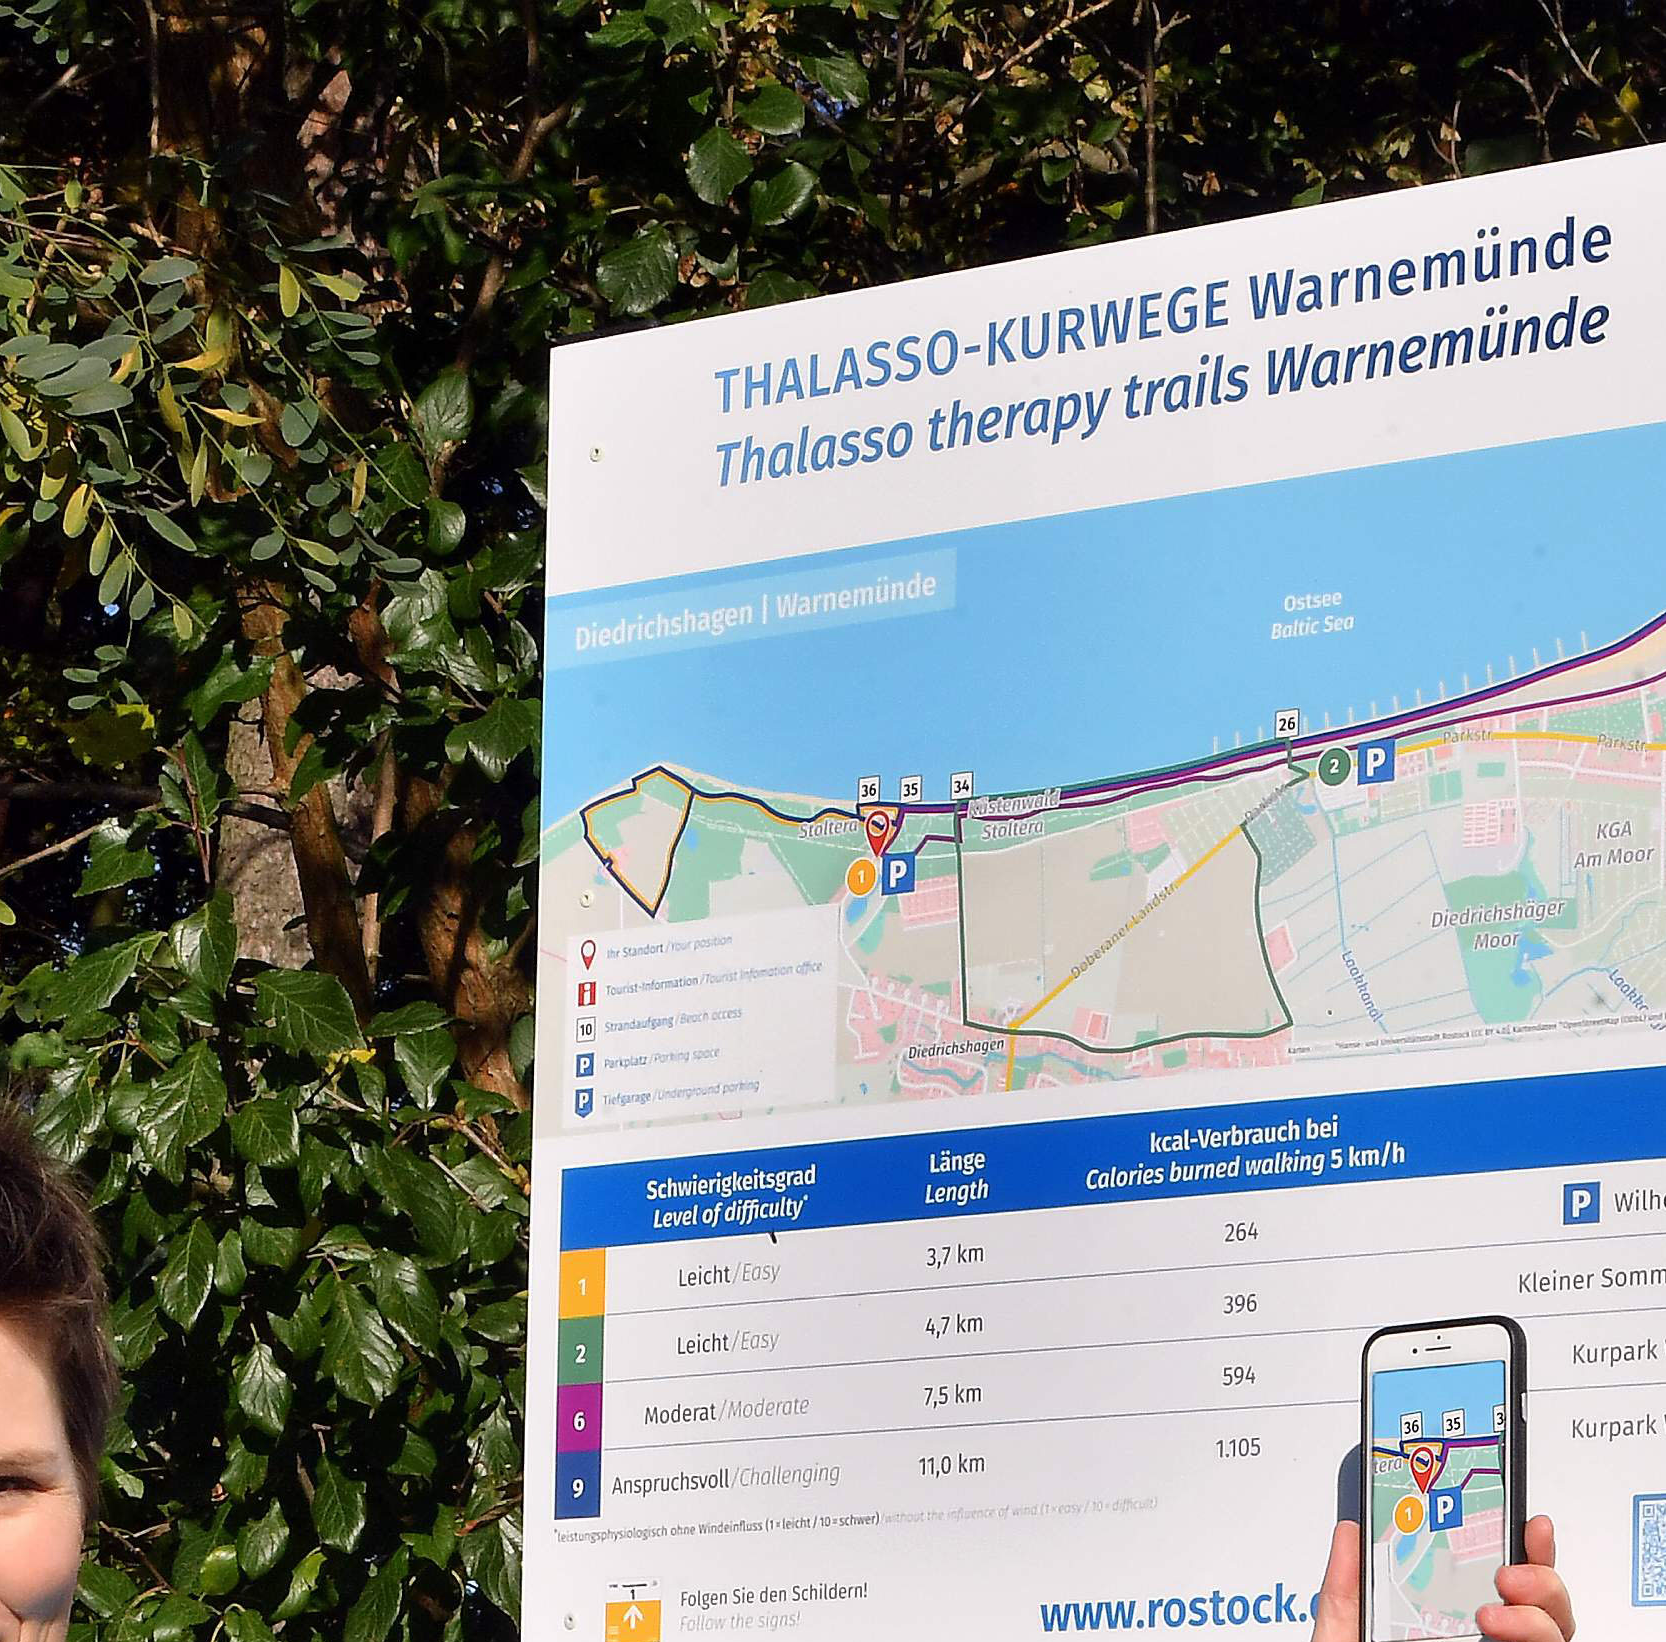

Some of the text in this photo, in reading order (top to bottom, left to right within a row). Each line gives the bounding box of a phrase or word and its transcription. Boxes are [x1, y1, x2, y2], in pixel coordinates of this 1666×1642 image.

[715, 216, 1611, 412] THALASSO-KURWEGE Warnemünde
[717, 296, 1609, 486] Thalasso therapy trails Warnemünde
[575, 606, 752, 651] Diedrichshagen
[777, 572, 936, 618] Warnemünde
[1285, 592, 1341, 611] Ostsee
[1271, 616, 1354, 639] Baltic Sea
[1279, 717, 1296, 732] 26
[1330, 758, 1340, 773] 2
[861, 783, 878, 798] 36
[903, 781, 919, 797] 35
[954, 779, 970, 794] 34
[798, 819, 858, 841] Stoltera
[982, 820, 1045, 841] Stoltera
[1596, 820, 1632, 841] KGA
[1574, 846, 1654, 870] Am Moor
[858, 870, 865, 884] 1
[1431, 899, 1566, 929] Diedrichshäger
[1474, 932, 1520, 950] Moor
[580, 1024, 593, 1037] 10
[908, 1038, 1005, 1060] Diedrichshagen
[1151, 1115, 1338, 1153] kcal-Verbrauch bei
[930, 1150, 985, 1175] Länge
[1087, 1141, 1404, 1189] Calories burned walking 5 km/h
[647, 1164, 815, 1199] Schwierigkeitsgrad
[925, 1179, 988, 1205] Length
[653, 1204, 699, 1229] Level
[701, 1203, 723, 1228] of
[1225, 1222, 1258, 1242] 264
[927, 1244, 983, 1269] 3,7 km
[578, 1279, 585, 1295] 1
[1520, 1270, 1594, 1293] Kleiner
[1224, 1294, 1256, 1314] 396
[926, 1314, 982, 1338] 4,7 km
[576, 1345, 585, 1363] 2
[1574, 1339, 1657, 1367] Kurpark
[1223, 1366, 1255, 1385] 594
[925, 1384, 981, 1408] 7,5 km
[574, 1412, 585, 1430] 6
[1404, 1419, 1420, 1434] 36
[1446, 1416, 1461, 1432] 35
[1573, 1414, 1656, 1441] Kurpark
[1216, 1438, 1260, 1458] 1.105
[919, 1453, 984, 1478] 11,0 km
[573, 1479, 583, 1498] 9
[1405, 1507, 1412, 1521] 1
[681, 1582, 867, 1610] Folgen Sie den Schildern!
